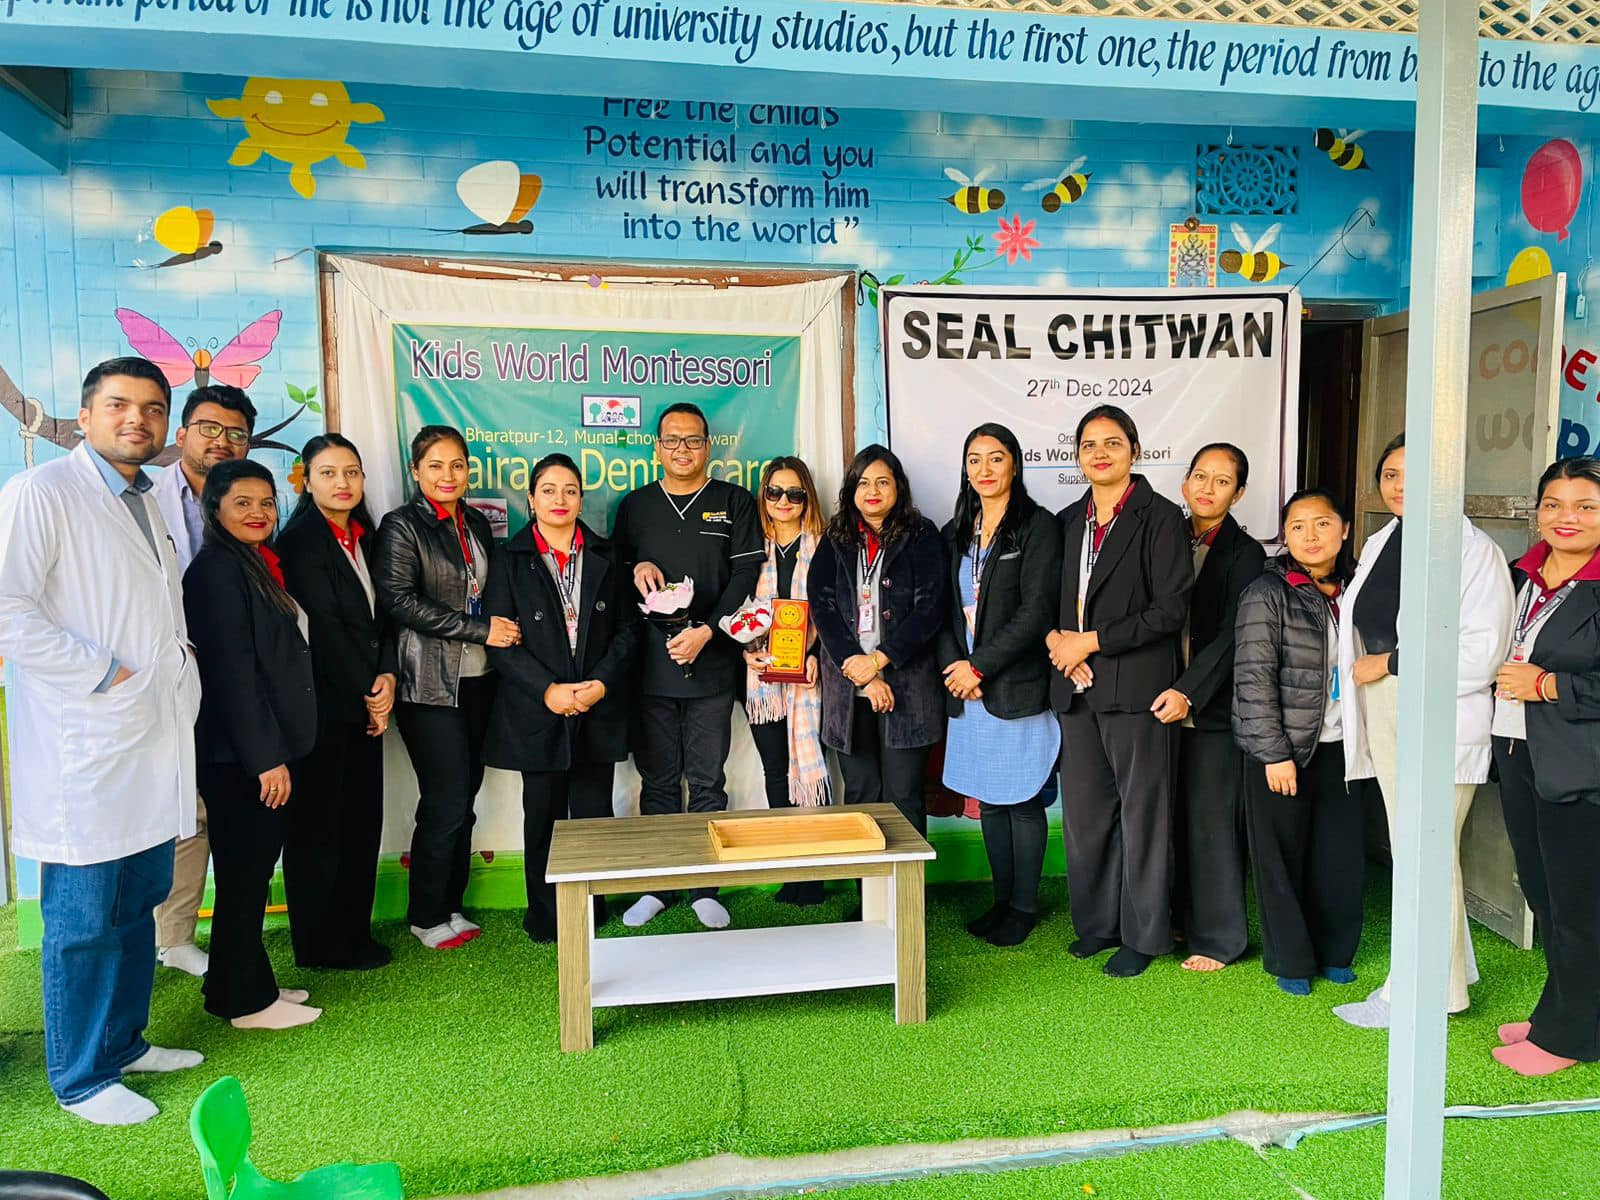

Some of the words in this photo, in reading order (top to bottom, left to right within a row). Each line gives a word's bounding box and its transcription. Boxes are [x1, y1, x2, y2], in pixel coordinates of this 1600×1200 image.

[503, 0, 563, 51] age
[572, 0, 609, 37] of
[612, 2, 763, 64] university
[967, 19, 1015, 62] the
[1022, 23, 1089, 64] first
[1220, 36, 1322, 86] period
[1326, 40, 1392, 83] from
[1478, 50, 1506, 88] to
[1512, 50, 1558, 91] the
[1565, 63, 1600, 112] ag
[583, 125, 737, 164] Potential
[750, 137, 812, 166] and
[821, 145, 874, 180] you
[595, 170, 648, 200] will
[657, 173, 814, 209] transform
[824, 179, 871, 209] him
[623, 212, 682, 241] into
[691, 214, 742, 242] the
[902, 309, 1032, 360] SEAL
[1047, 310, 1274, 360] CHITWAN
[410, 339, 482, 382] Kids
[492, 342, 589, 384] World
[602, 346, 773, 387] Montessori
[1026, 378, 1060, 398] 27th
[1066, 378, 1103, 397] Dec
[1107, 378, 1154, 397] 2024
[465, 427, 568, 446] Bharatpur-12,
[574, 430, 658, 446] Munal-cho
[1046, 448, 1074, 462] Wor
[468, 446, 541, 491] aira
[581, 447, 662, 492] Dent
